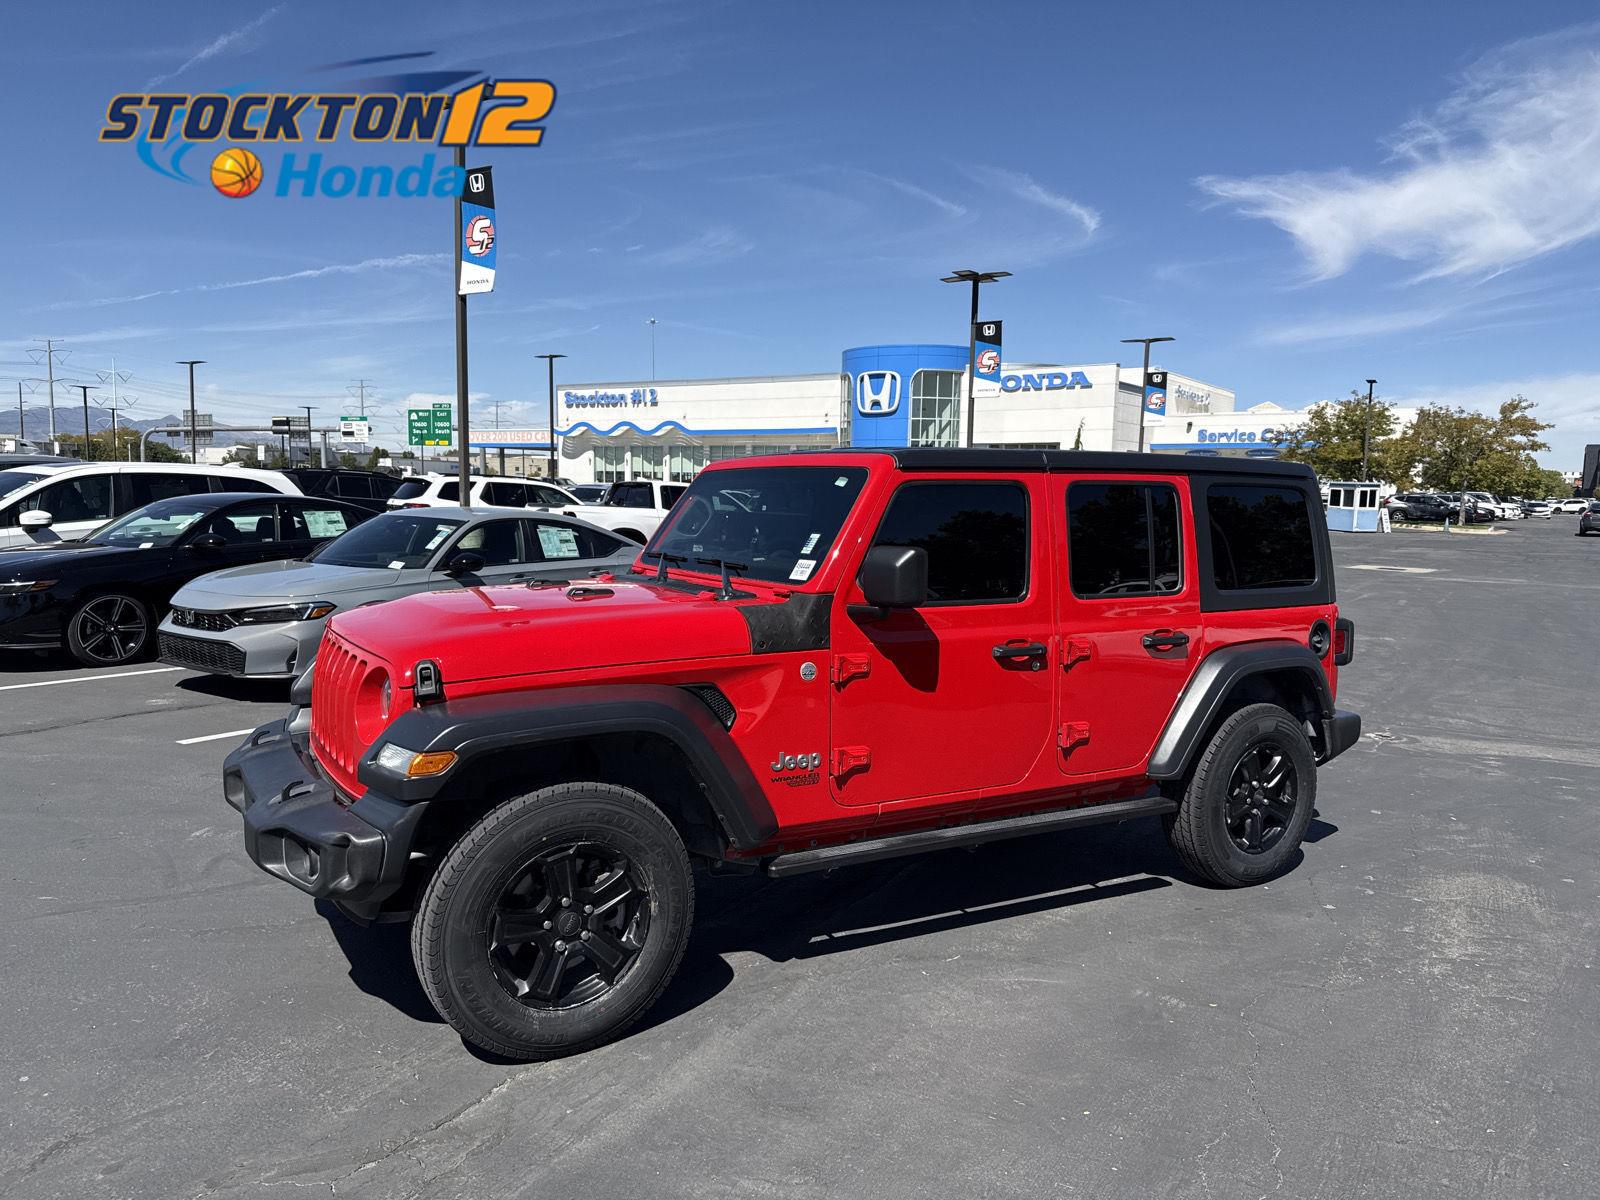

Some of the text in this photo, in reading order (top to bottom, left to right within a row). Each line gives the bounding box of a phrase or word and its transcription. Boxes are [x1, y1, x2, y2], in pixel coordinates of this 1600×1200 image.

[999, 371, 1094, 393] ONDA
[564, 390, 628, 408] Stockton
[492, 431, 508, 442] 200
[509, 431, 533, 442] USED
[1197, 428, 1257, 443] Service
[770, 751, 821, 772] Jeep
